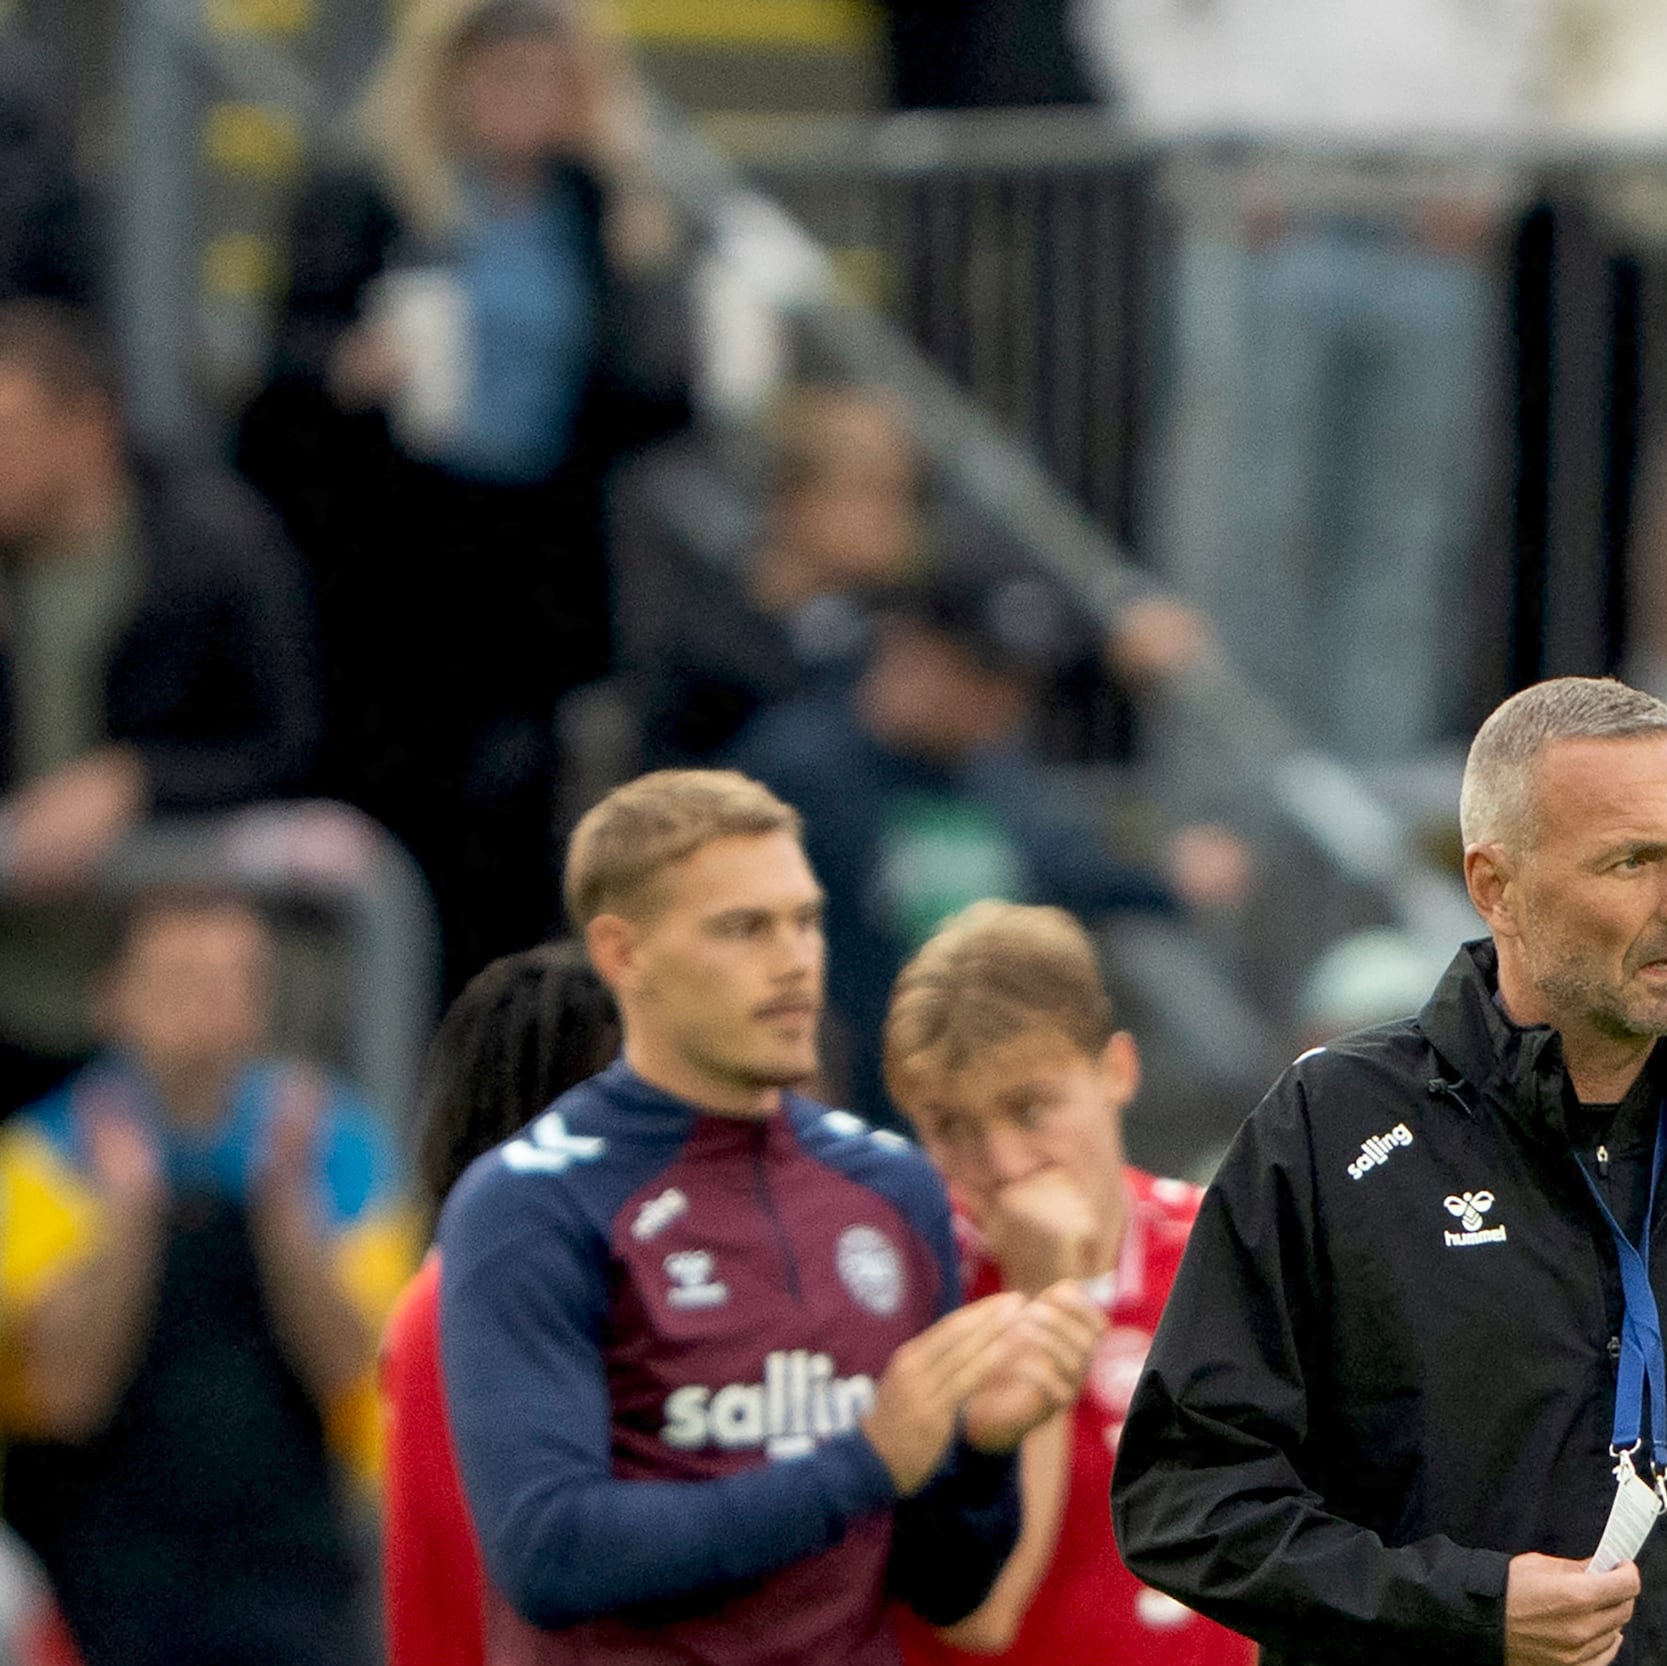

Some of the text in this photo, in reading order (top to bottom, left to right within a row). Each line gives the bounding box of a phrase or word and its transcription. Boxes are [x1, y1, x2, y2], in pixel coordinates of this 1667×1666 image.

[1347, 1122, 1413, 1180] salling
[1444, 1224, 1507, 1246] hummel
[661, 1349, 877, 1458] sallin
